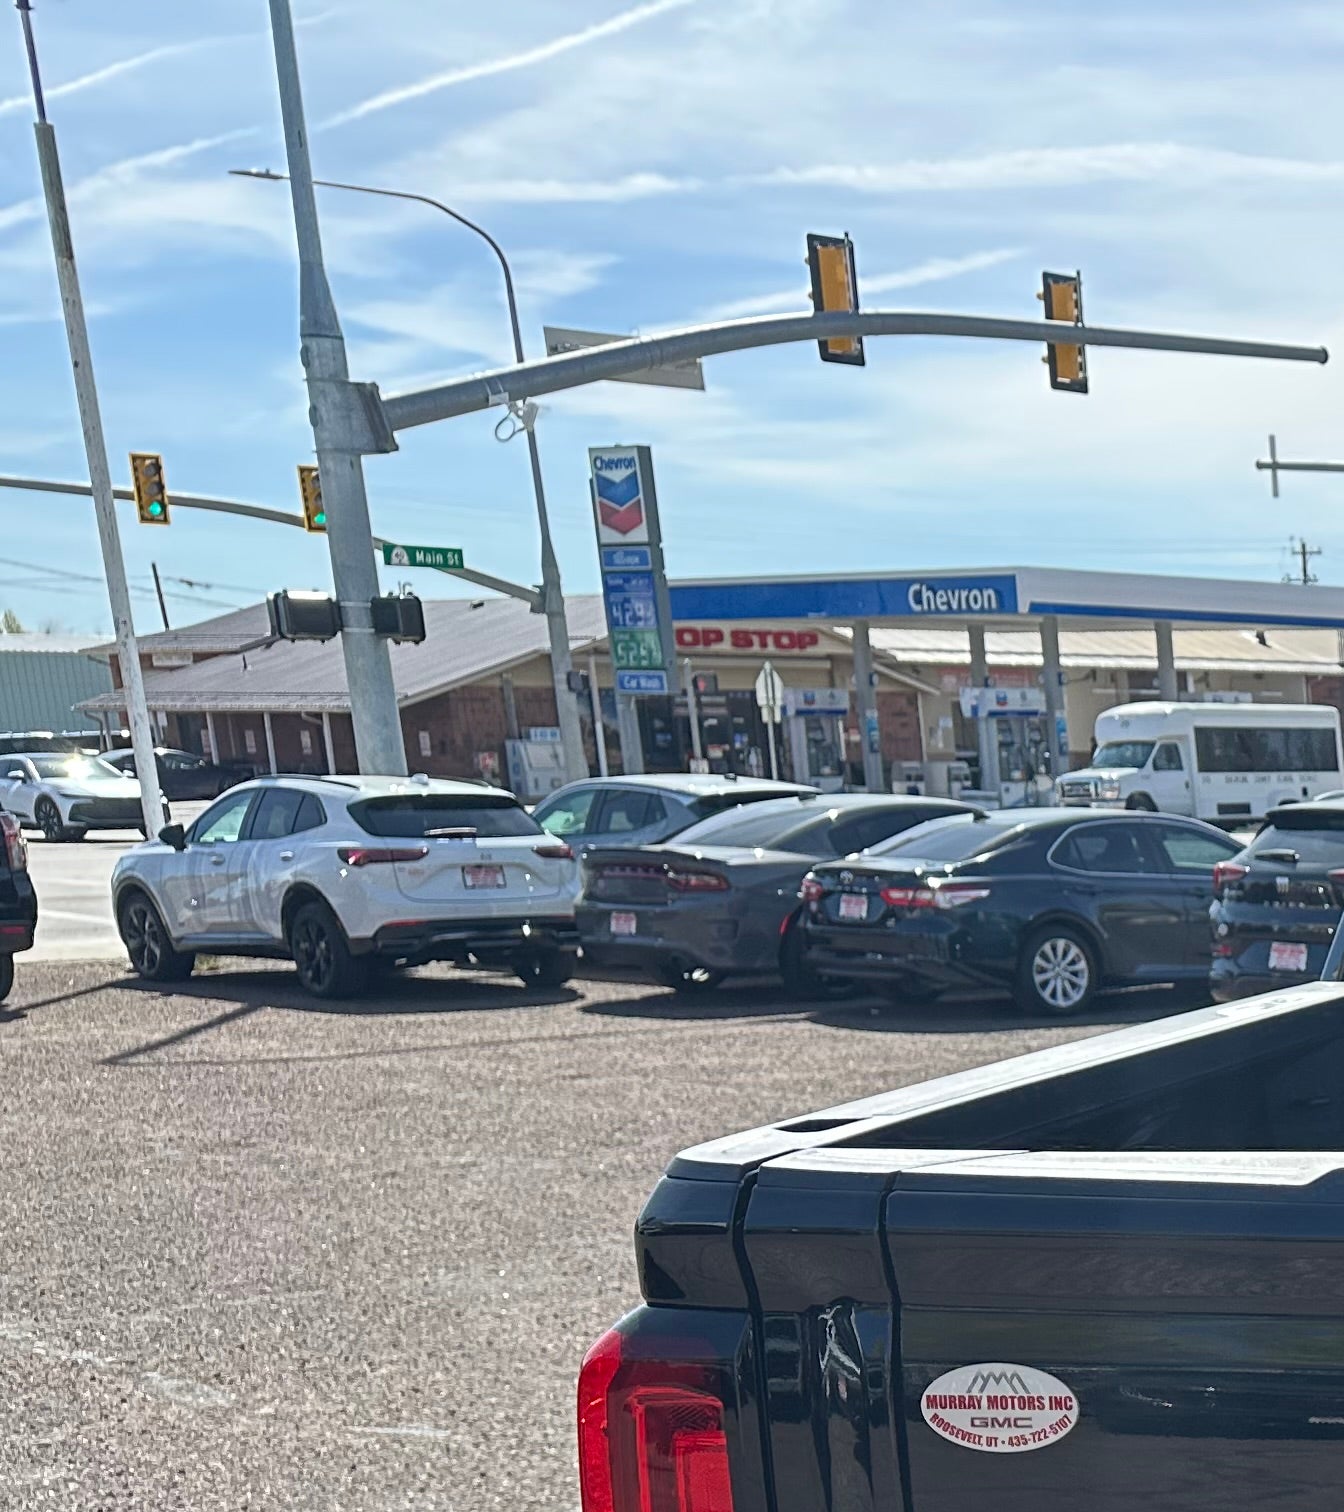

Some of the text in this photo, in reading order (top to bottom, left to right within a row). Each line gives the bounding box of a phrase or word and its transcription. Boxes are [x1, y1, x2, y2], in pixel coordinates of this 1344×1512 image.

[594, 456, 637, 471] Chevron
[415, 549, 443, 565] Main
[446, 551, 459, 566] St
[908, 583, 998, 612] Chevron
[675, 628, 820, 650] OP STOP
[926, 1394, 1074, 1412] MURRAY MOTORS INC
[929, 1412, 1073, 1448] ROOSEVELT, UT 435-722-5107
[970, 1416, 1033, 1429] GMC
